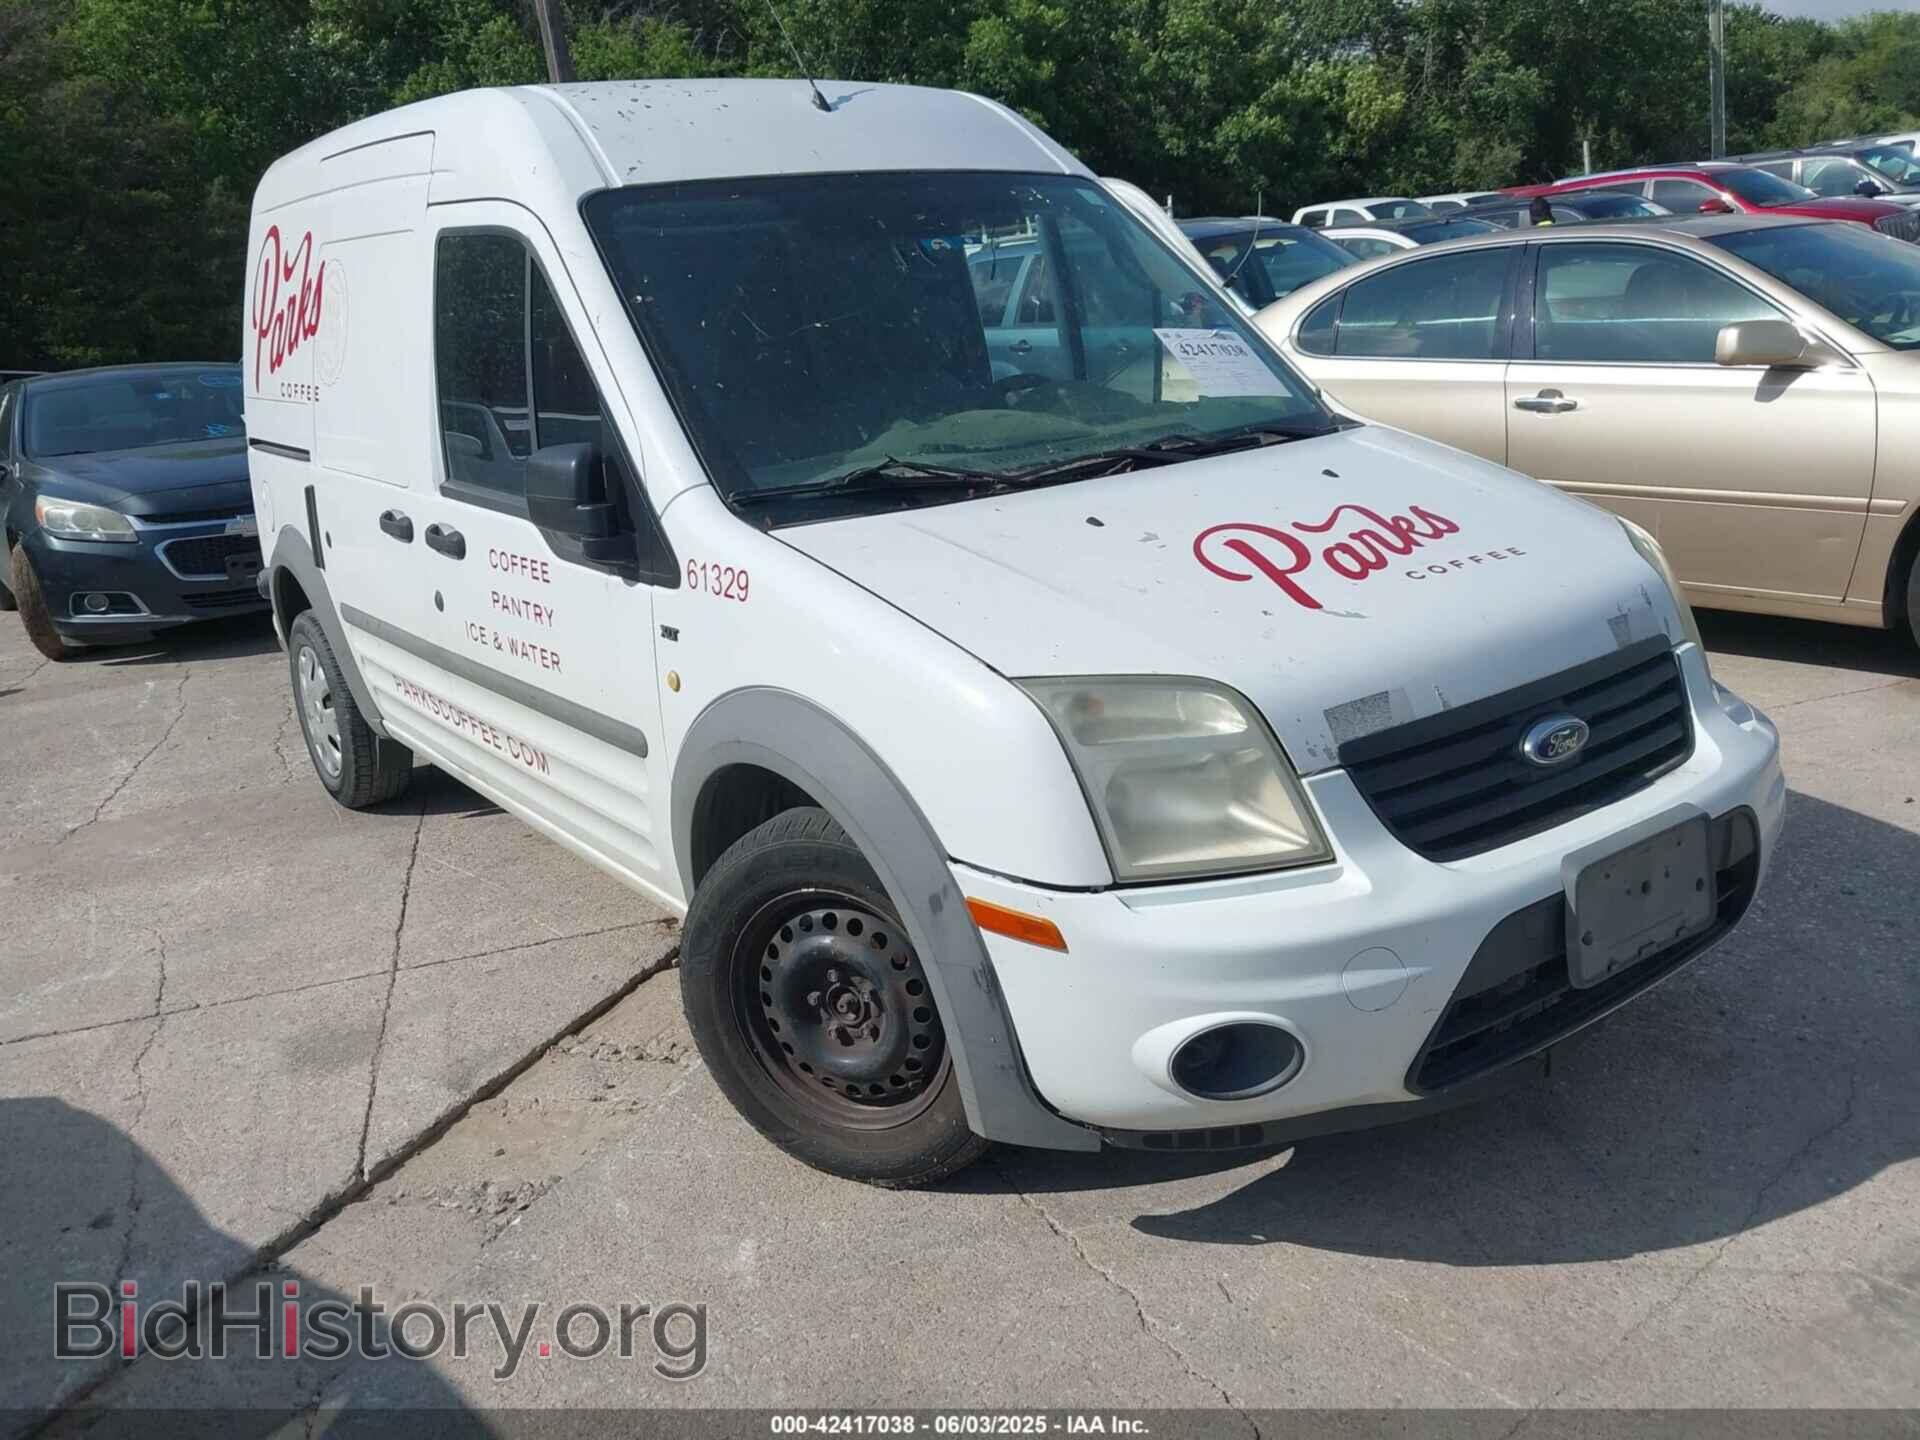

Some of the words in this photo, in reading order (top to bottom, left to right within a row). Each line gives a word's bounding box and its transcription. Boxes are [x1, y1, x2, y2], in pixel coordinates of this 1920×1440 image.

[252, 225, 326, 393] Parks
[280, 382, 320, 402] COFFEE
[489, 548, 551, 584] COFFEE
[1192, 503, 1460, 610] Parks
[1405, 546, 1527, 581] COFFEE
[686, 558, 750, 602] 61329
[491, 591, 554, 628] PANTRY
[465, 620, 488, 646] ICE
[493, 631, 504, 651] &
[508, 639, 562, 674] WATER
[392, 672, 551, 776] PARKSCOFFEE.COM
